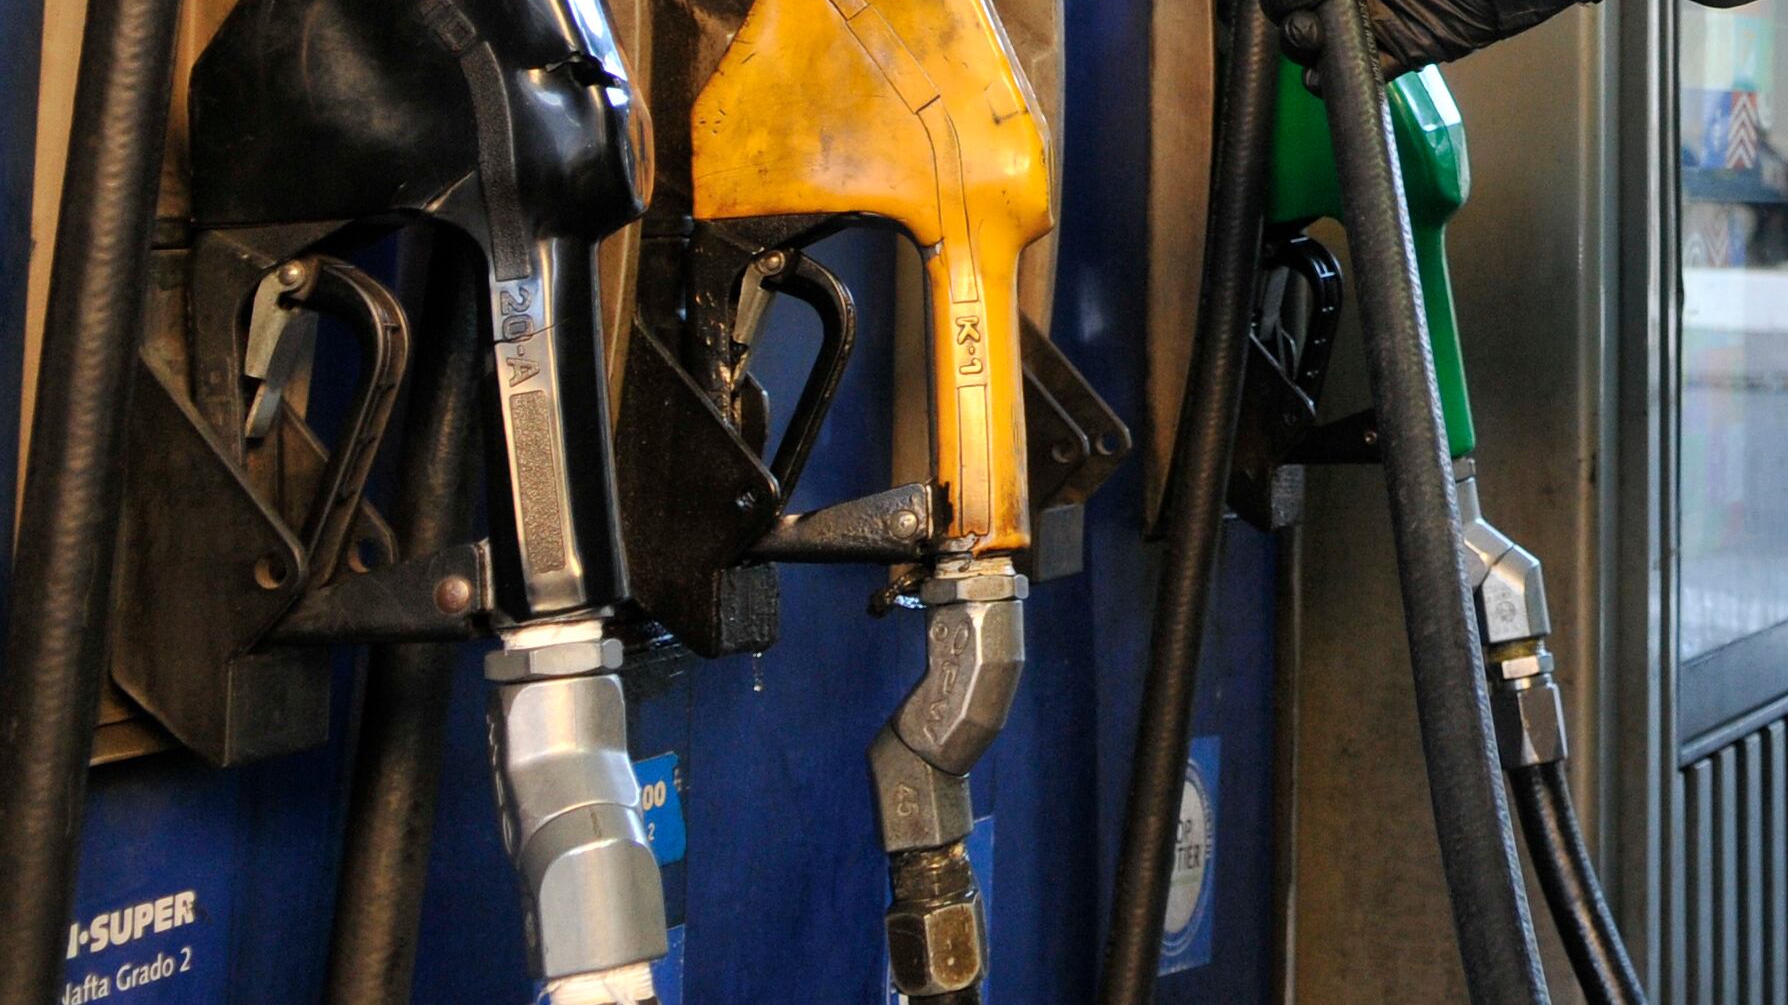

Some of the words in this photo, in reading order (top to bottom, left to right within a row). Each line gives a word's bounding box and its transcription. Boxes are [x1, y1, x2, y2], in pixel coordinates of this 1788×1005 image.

[499, 286, 541, 389] 20-A
[955, 315, 983, 375] K-1
[116, 952, 175, 991] Grado
[179, 946, 191, 972] 2
